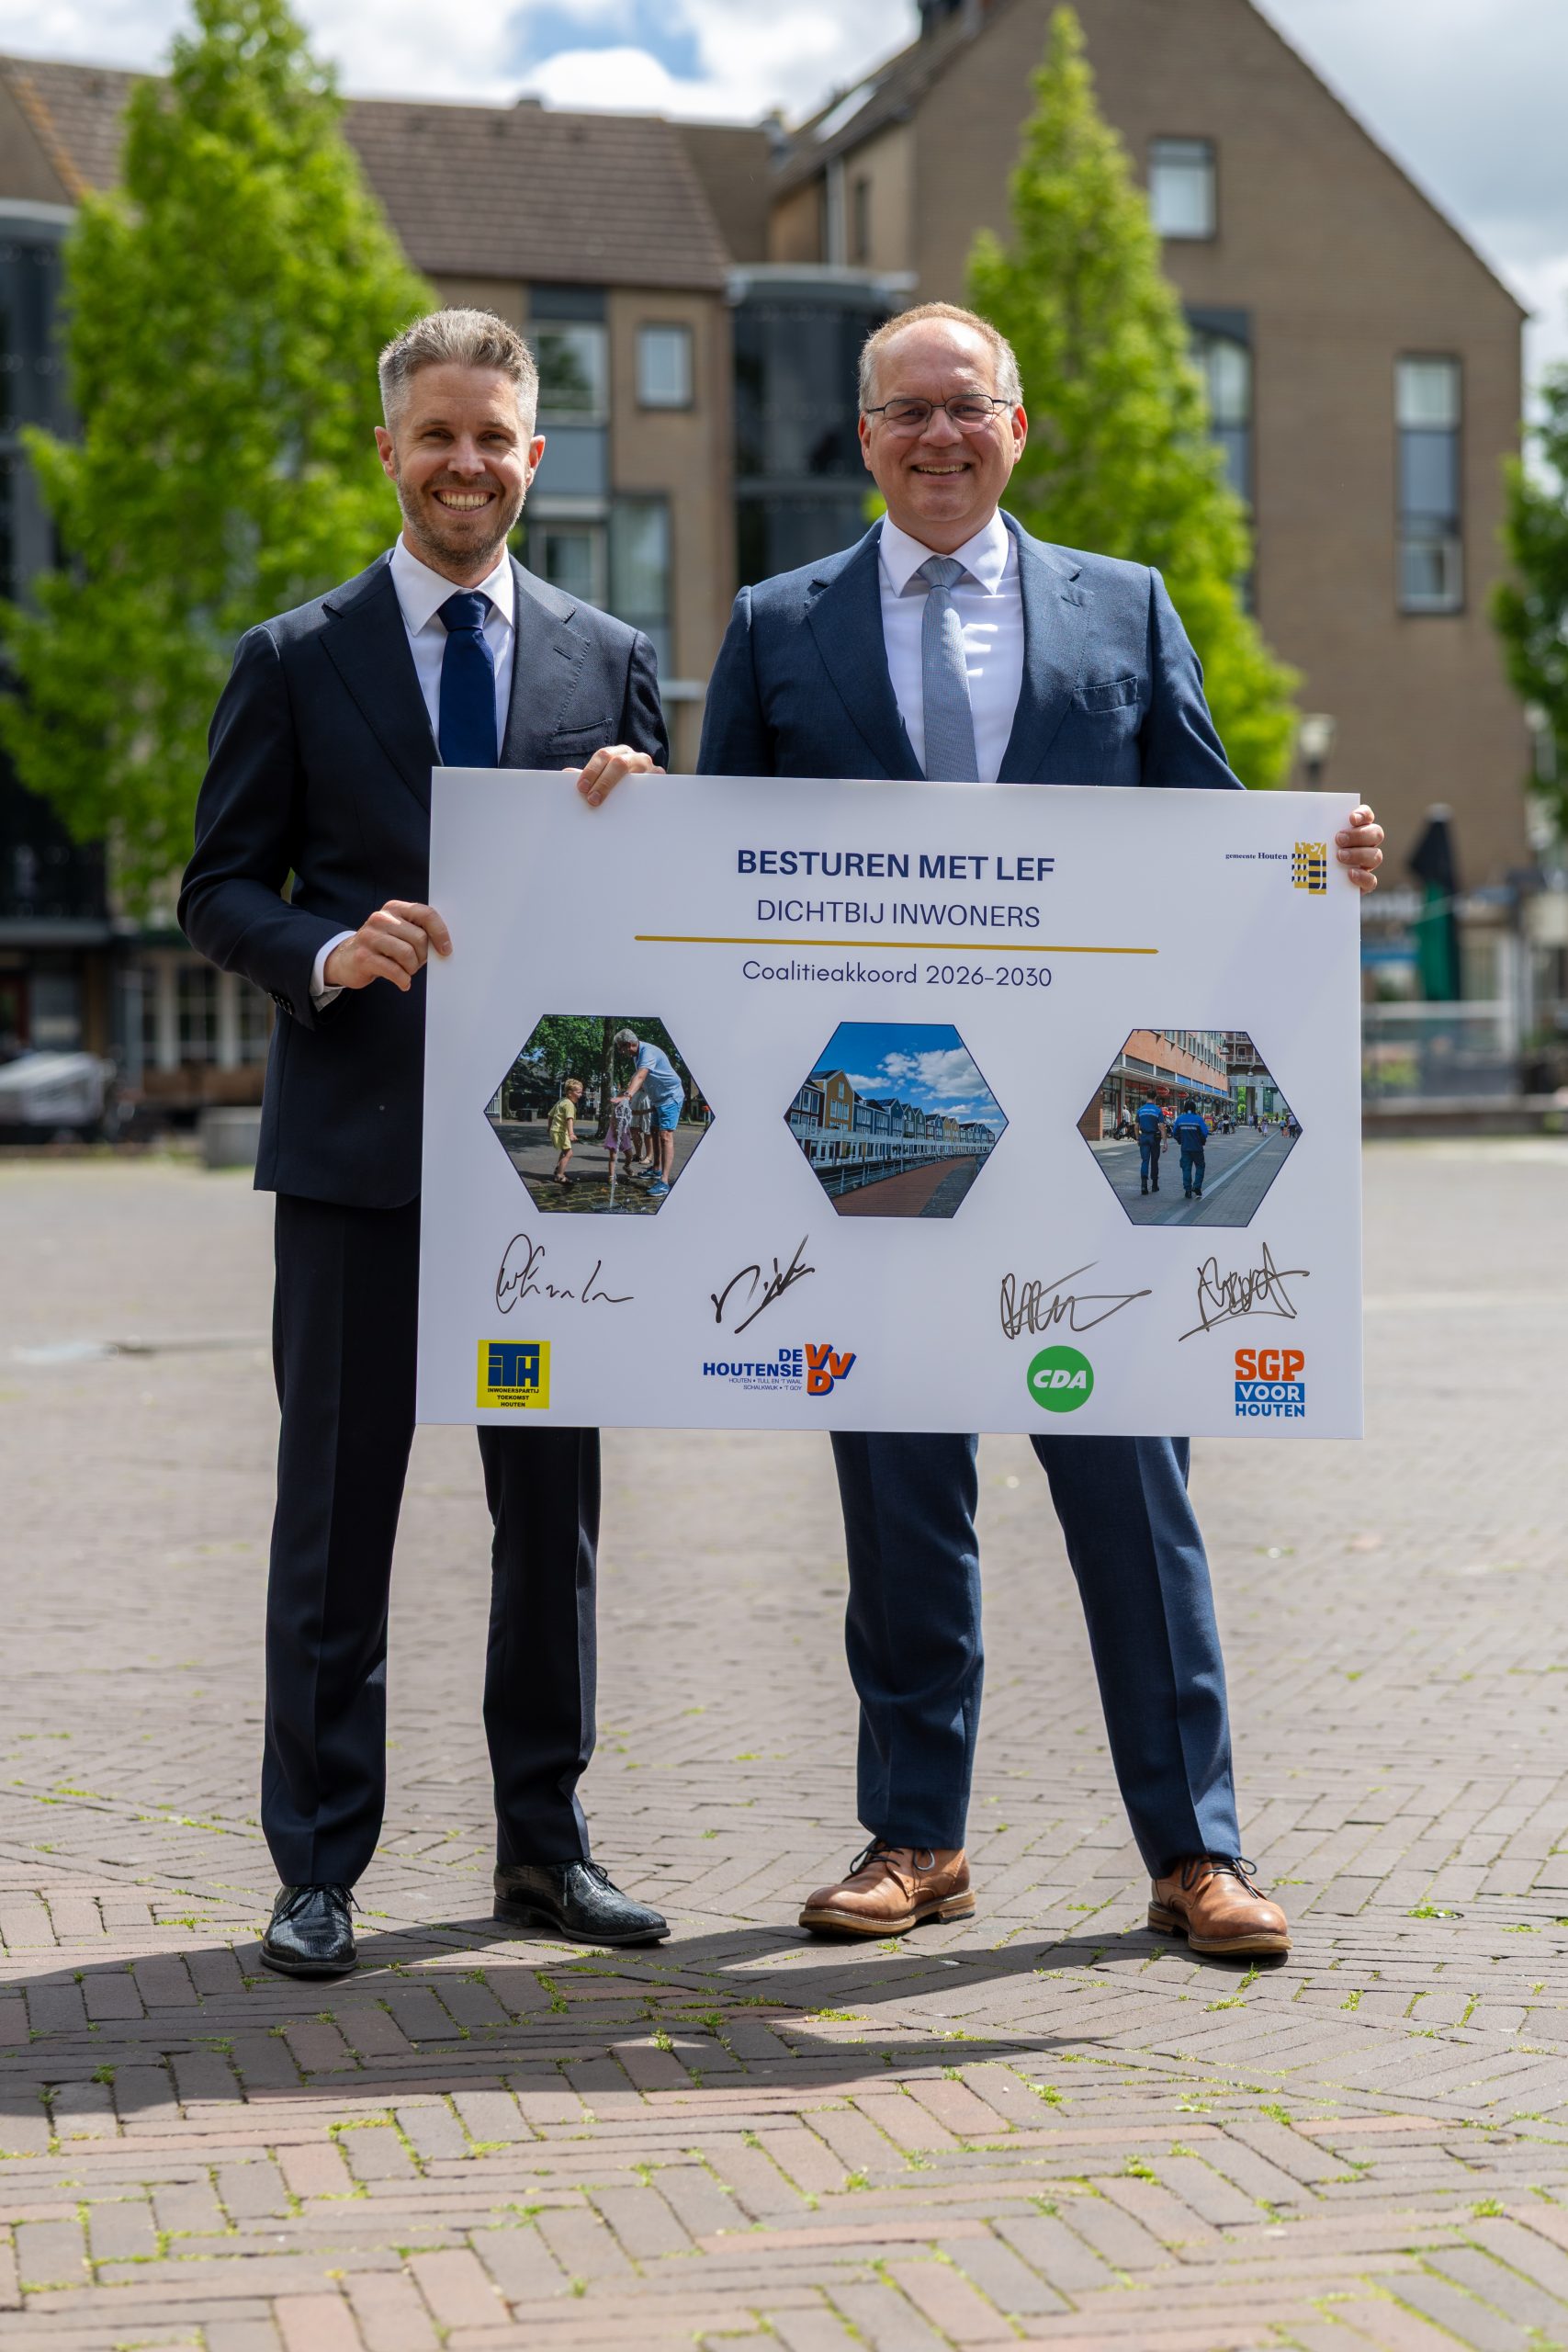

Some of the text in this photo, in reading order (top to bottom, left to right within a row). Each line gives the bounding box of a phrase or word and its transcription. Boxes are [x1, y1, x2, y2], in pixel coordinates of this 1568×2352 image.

[737, 849, 1055, 882] BESTUREN MET LEF
[757, 899, 1041, 928] DICHTBIJ INWONERS
[742, 960, 918, 984] Coalitieakkoord
[779, 1349, 803, 1362] DE
[703, 1363, 803, 1377] HOUTENSE
[1235, 1349, 1305, 1382] SGP
[1033, 1370, 1087, 1389] CDA
[1239, 1385, 1301, 1401] VOOR
[1235, 1404, 1305, 1418] HOUTEN
